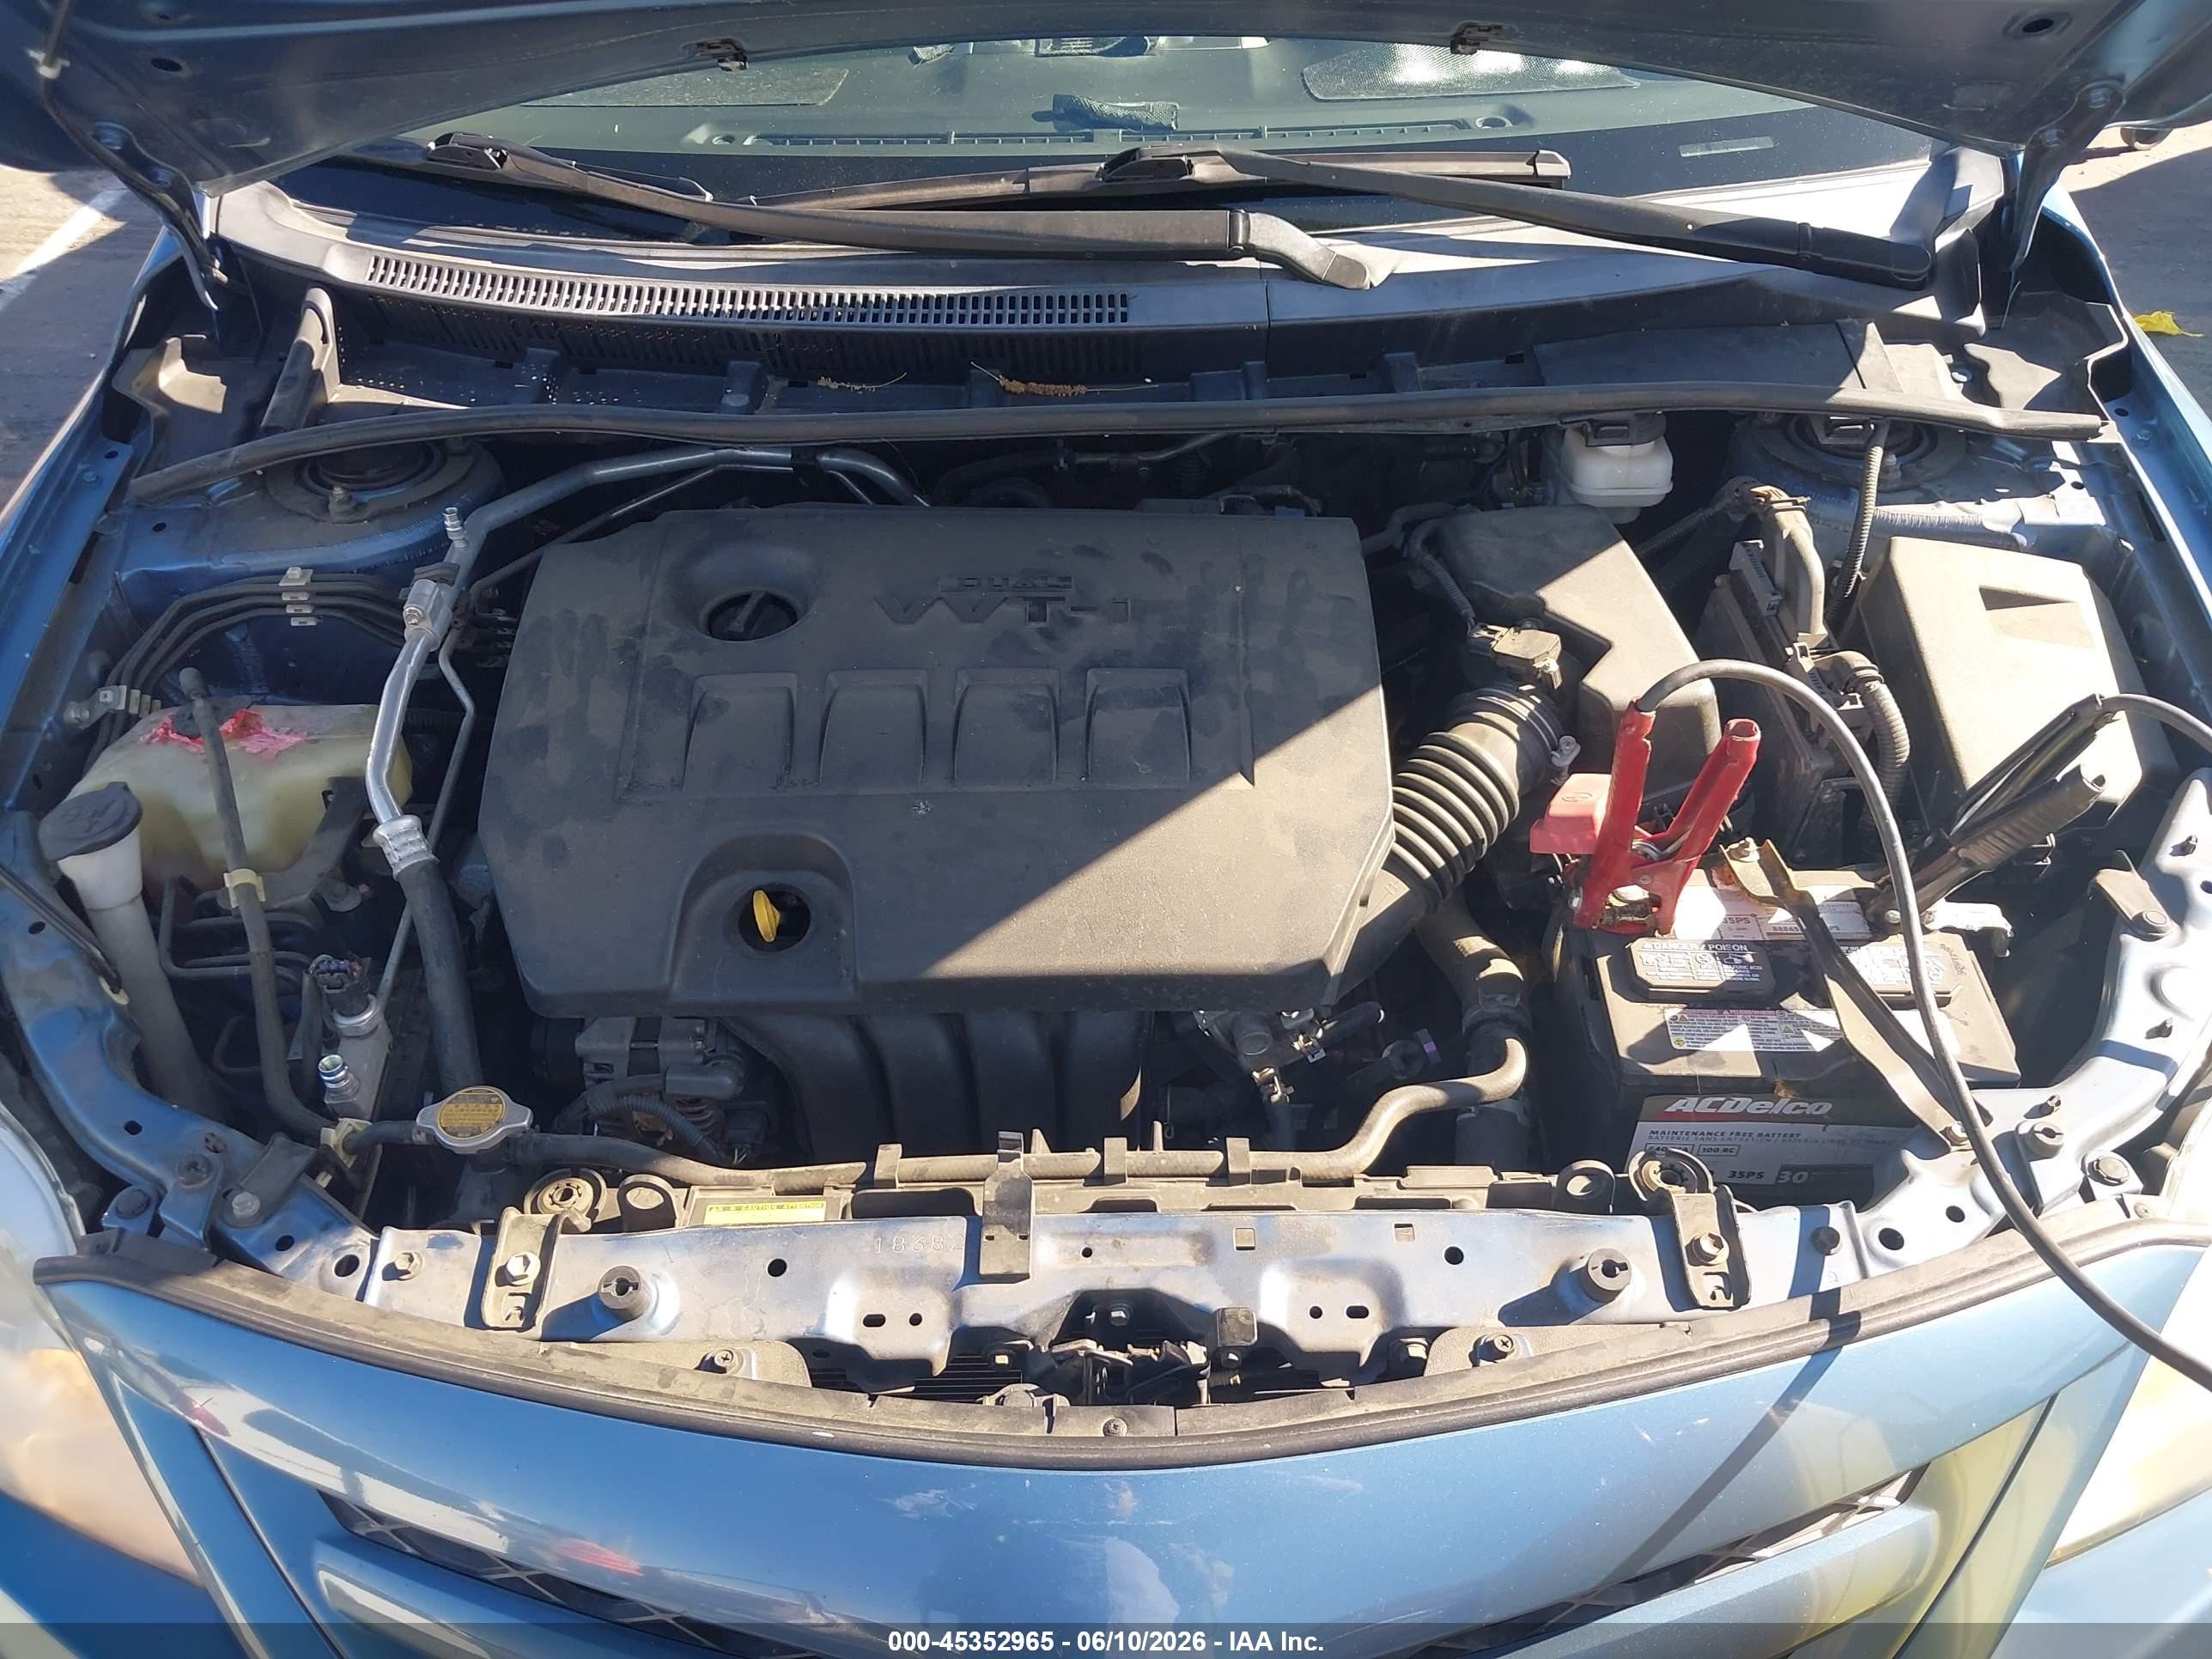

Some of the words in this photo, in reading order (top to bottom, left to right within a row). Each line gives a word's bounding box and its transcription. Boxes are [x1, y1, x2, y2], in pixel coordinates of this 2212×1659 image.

[1664, 1097, 1833, 1115] ACDelco
[1649, 1129, 1726, 1138] MAINTENANCE
[1728, 1170, 1765, 1180] 35PS
[1778, 1170, 1809, 1183] 30
